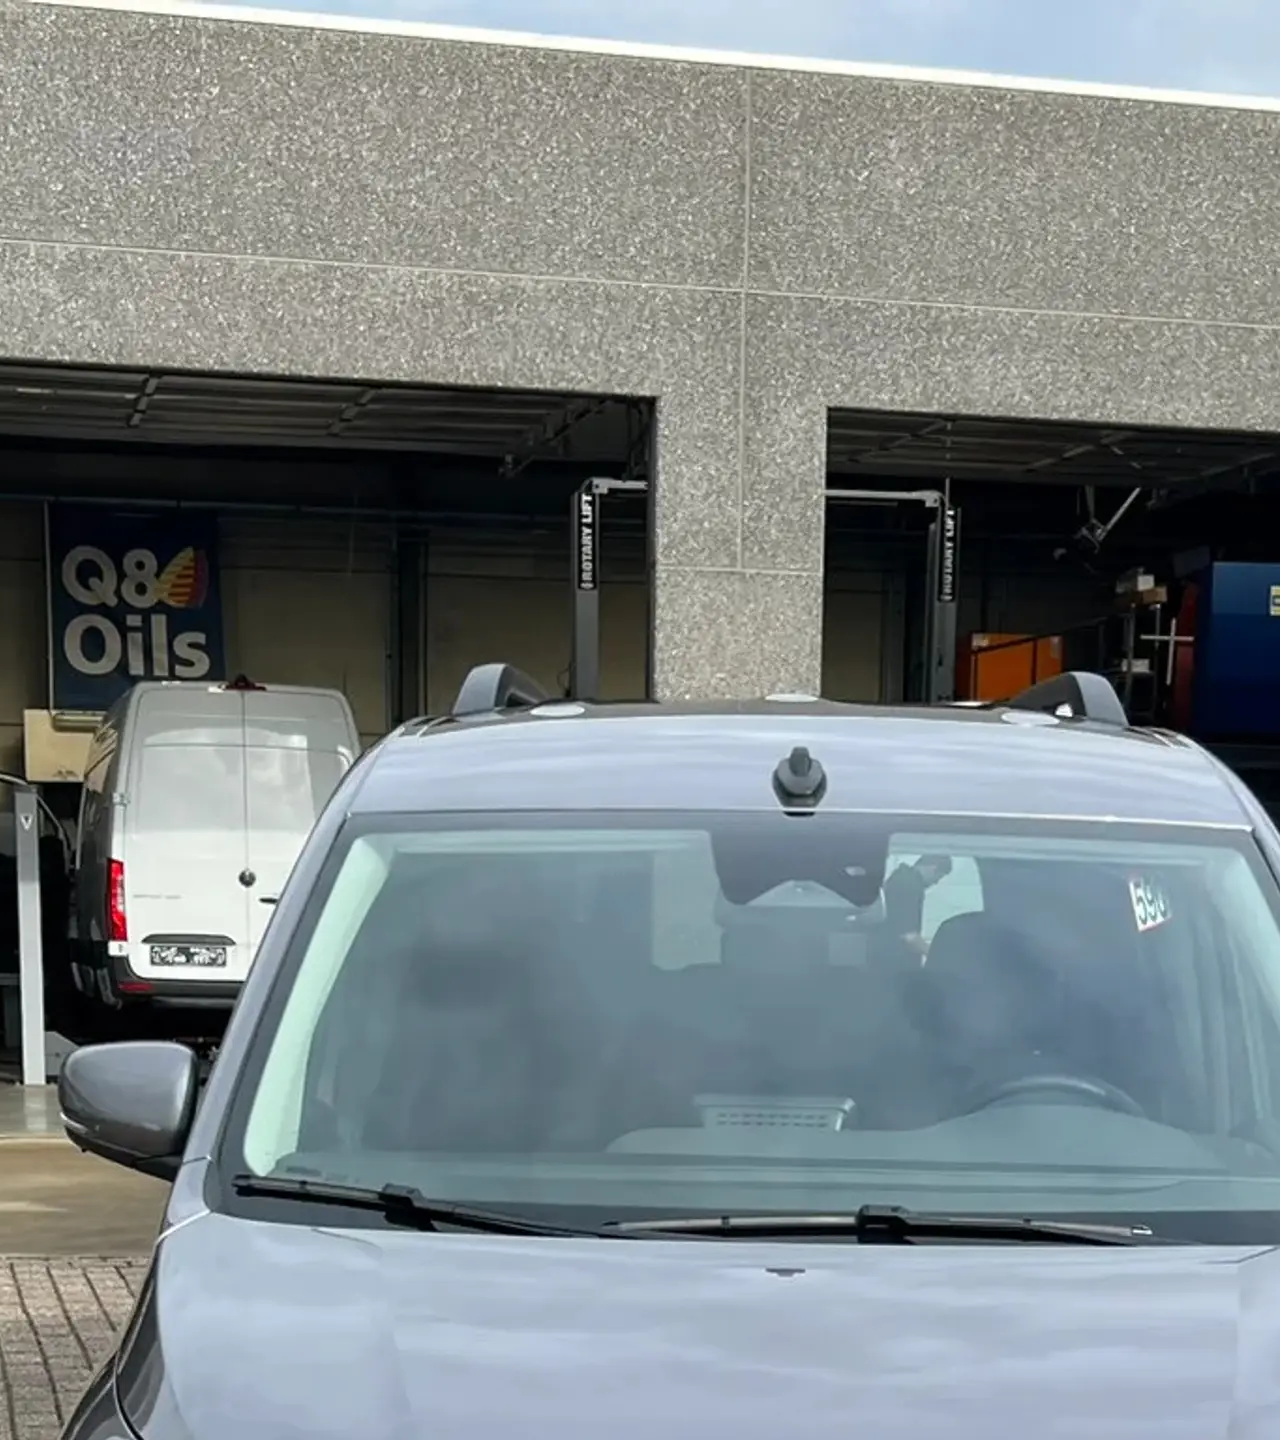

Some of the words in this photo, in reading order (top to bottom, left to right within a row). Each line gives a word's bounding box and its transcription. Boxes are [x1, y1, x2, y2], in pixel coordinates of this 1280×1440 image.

[581, 493, 593, 523] LIFT
[61, 545, 158, 608] Q8
[581, 526, 593, 581] ROTARY
[63, 613, 211, 678] Oils
